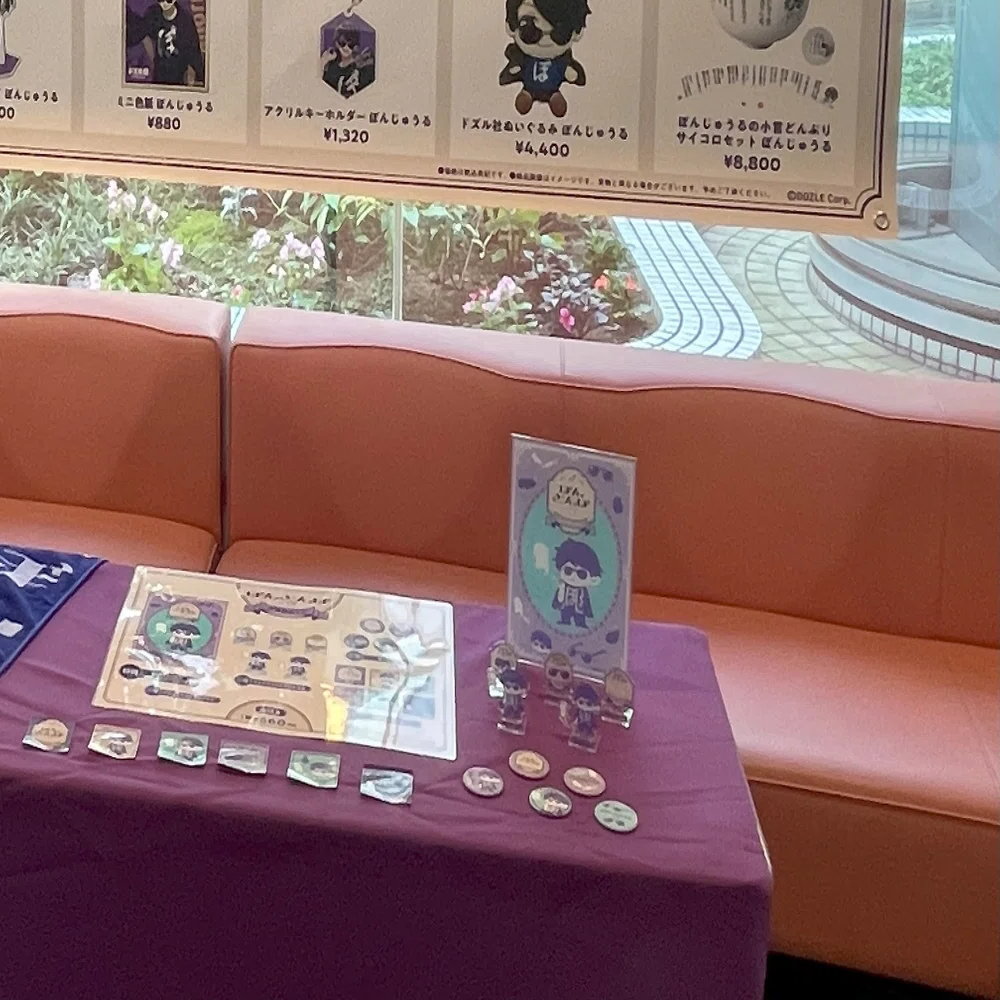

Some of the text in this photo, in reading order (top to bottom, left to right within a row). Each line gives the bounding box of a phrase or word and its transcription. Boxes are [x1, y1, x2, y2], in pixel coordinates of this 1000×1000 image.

[147, 115, 181, 130] ¥880
[324, 127, 369, 144] ¥1,320
[515, 140, 570, 158] ¥4,400
[724, 154, 781, 172] ¥8,800
